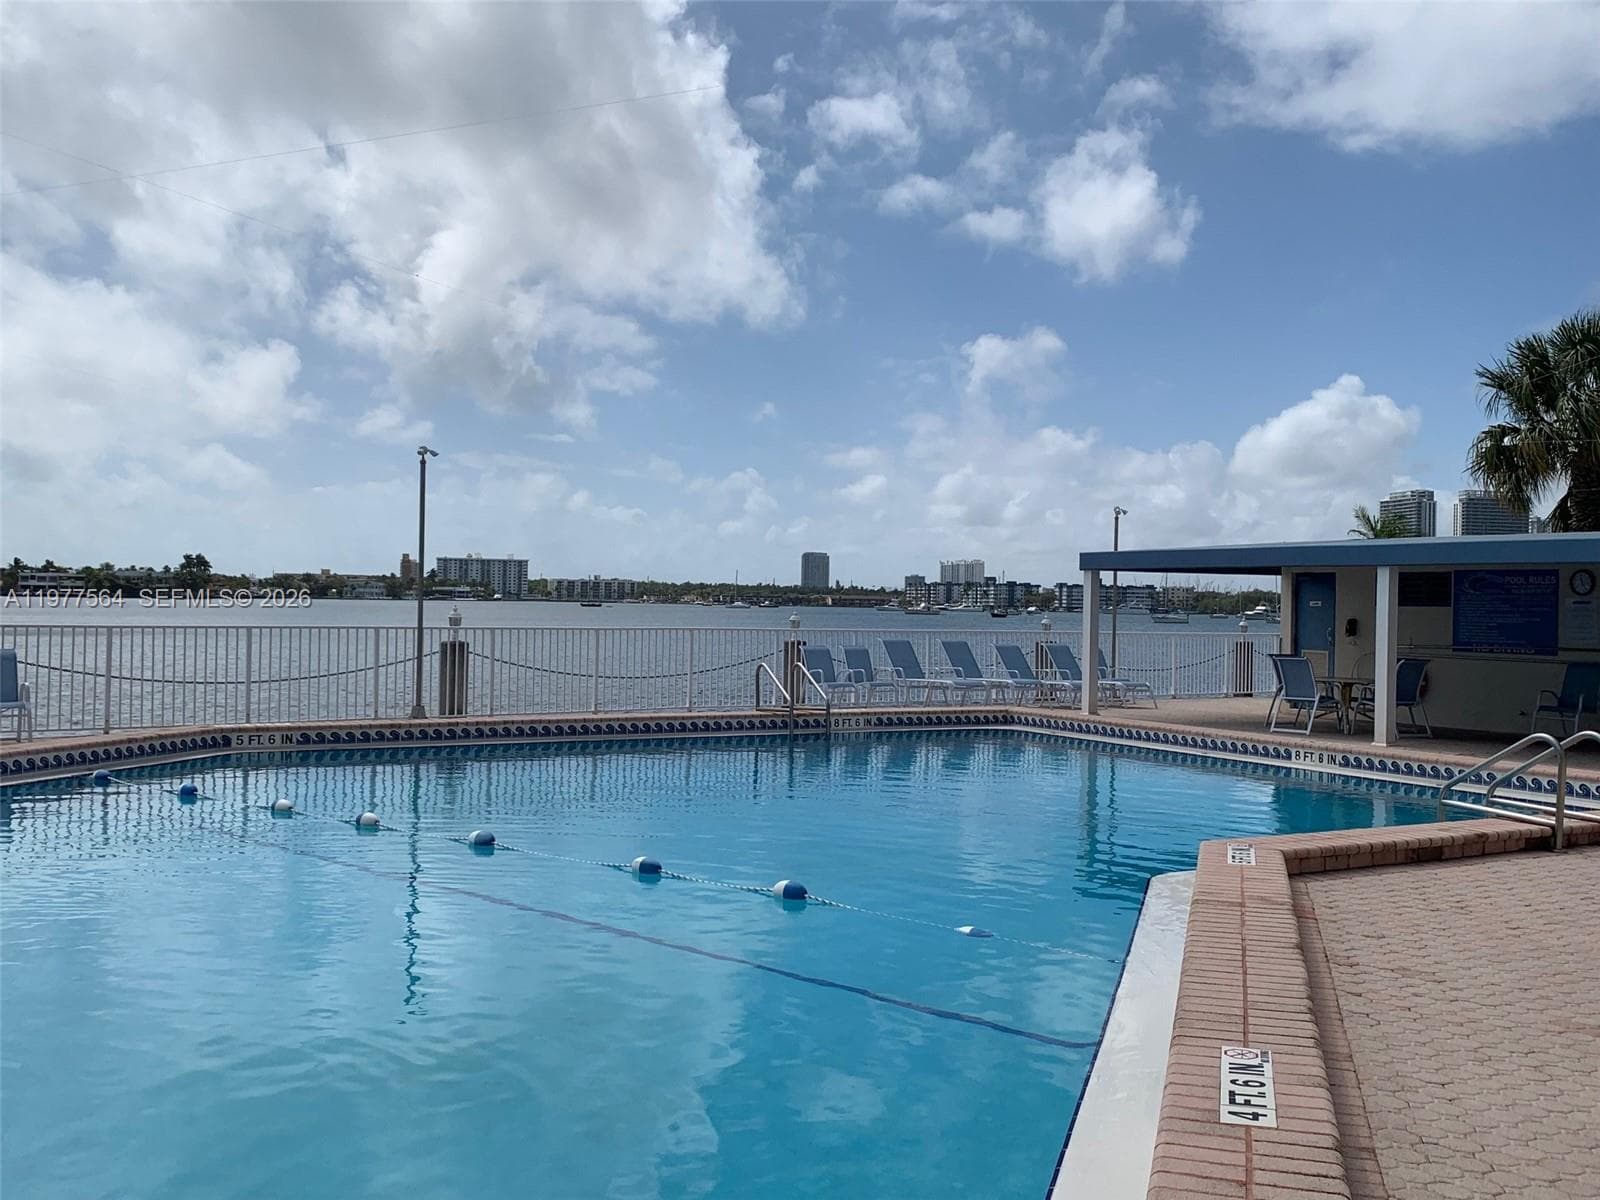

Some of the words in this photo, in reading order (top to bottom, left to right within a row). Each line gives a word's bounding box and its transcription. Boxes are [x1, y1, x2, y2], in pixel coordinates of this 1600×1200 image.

[1504, 575, 1528, 584] POOL
[1528, 575, 1556, 584] RULES
[834, 718, 840, 728] 8
[855, 718, 861, 727] 6
[236, 735, 244, 746] 5
[248, 734, 264, 746] FT.
[268, 734, 276, 745] 6
[1295, 750, 1301, 761] 8
[1228, 1062, 1265, 1077] IN.
[1229, 1078, 1266, 1088] 6
[1228, 1090, 1268, 1108] FT.
[1227, 1110, 1268, 1121] 4
